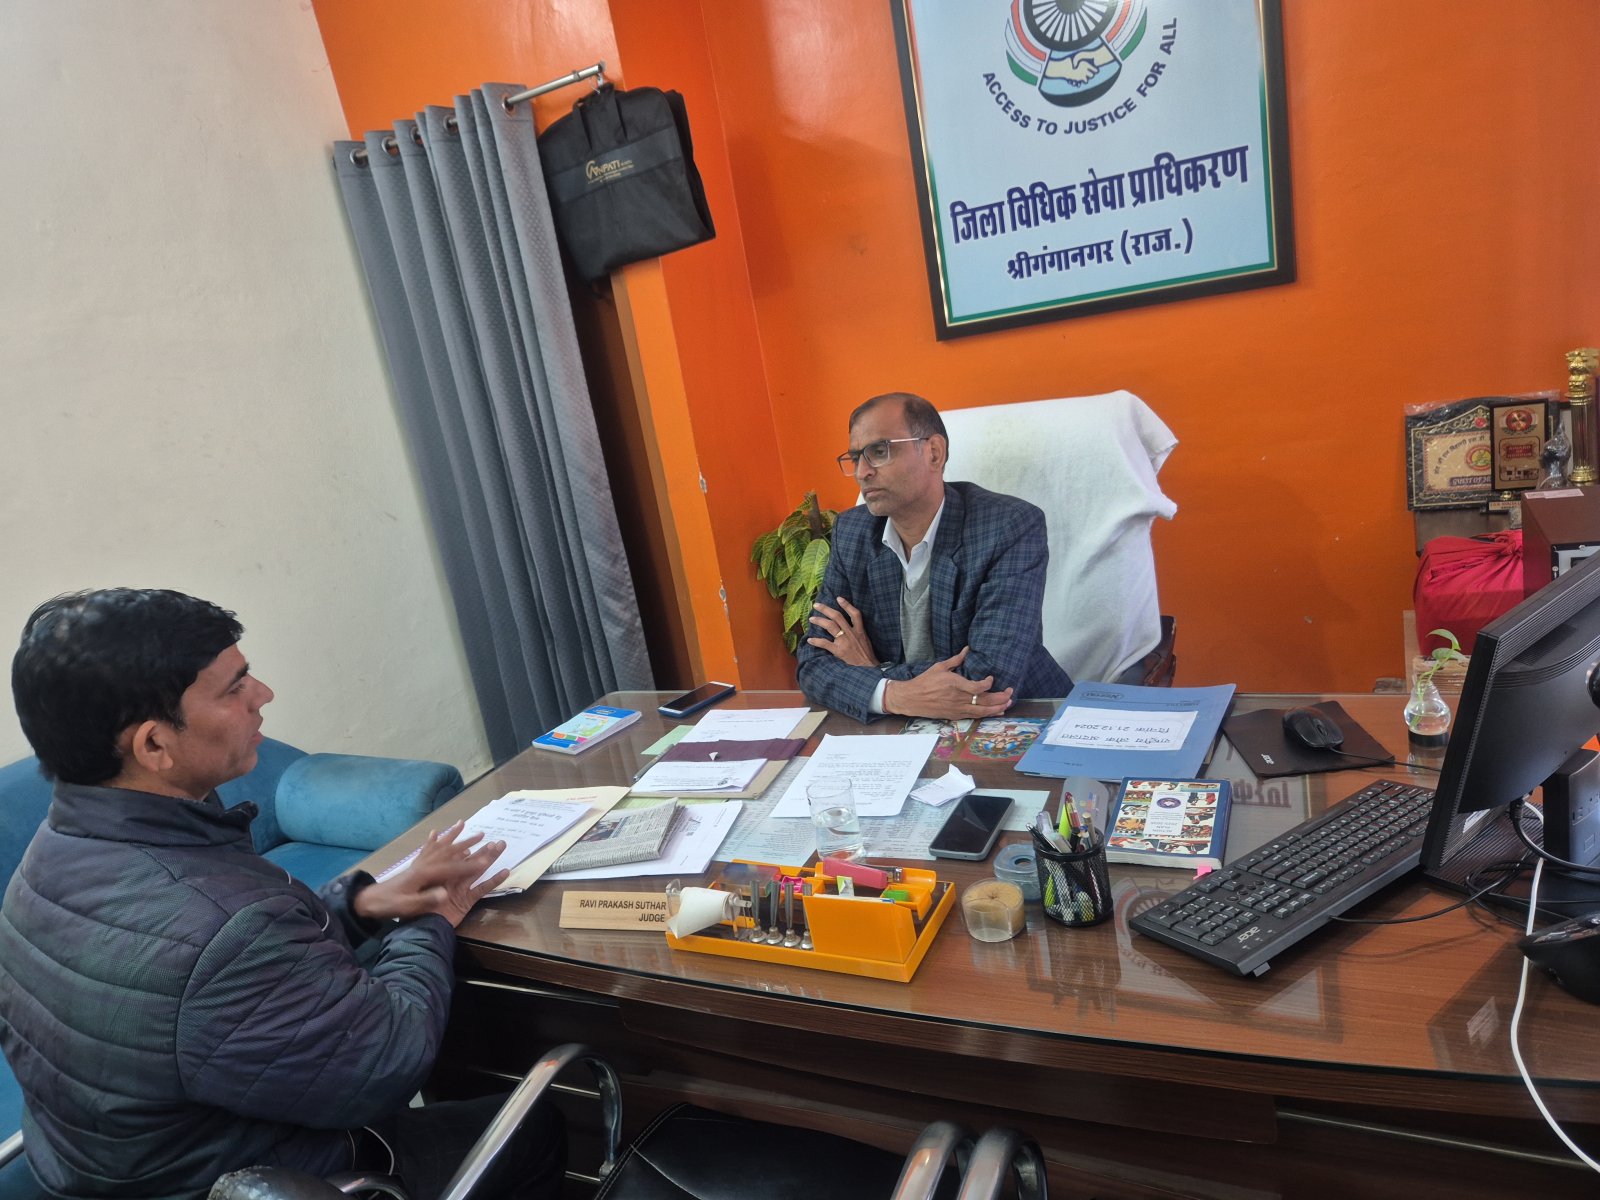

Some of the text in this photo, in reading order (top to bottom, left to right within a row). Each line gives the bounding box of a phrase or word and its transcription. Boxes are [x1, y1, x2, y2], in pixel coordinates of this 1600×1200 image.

[983, 17, 1177, 136] ACCESS TO JUSTICE FOR ALL
[949, 145, 1249, 244] जिला विधिक सेवा प्राधिकरण
[1007, 217, 1193, 280] श्रीगंगानगर (राज.)
[1075, 724, 1130, 732] 21.12.2024
[1135, 736, 1171, 745] राष्ट्रीय
[580, 899, 667, 910] RAVI PRAKASH SUTHAR
[639, 913, 665, 923] JUDGE
[1237, 926, 1261, 943] acer
